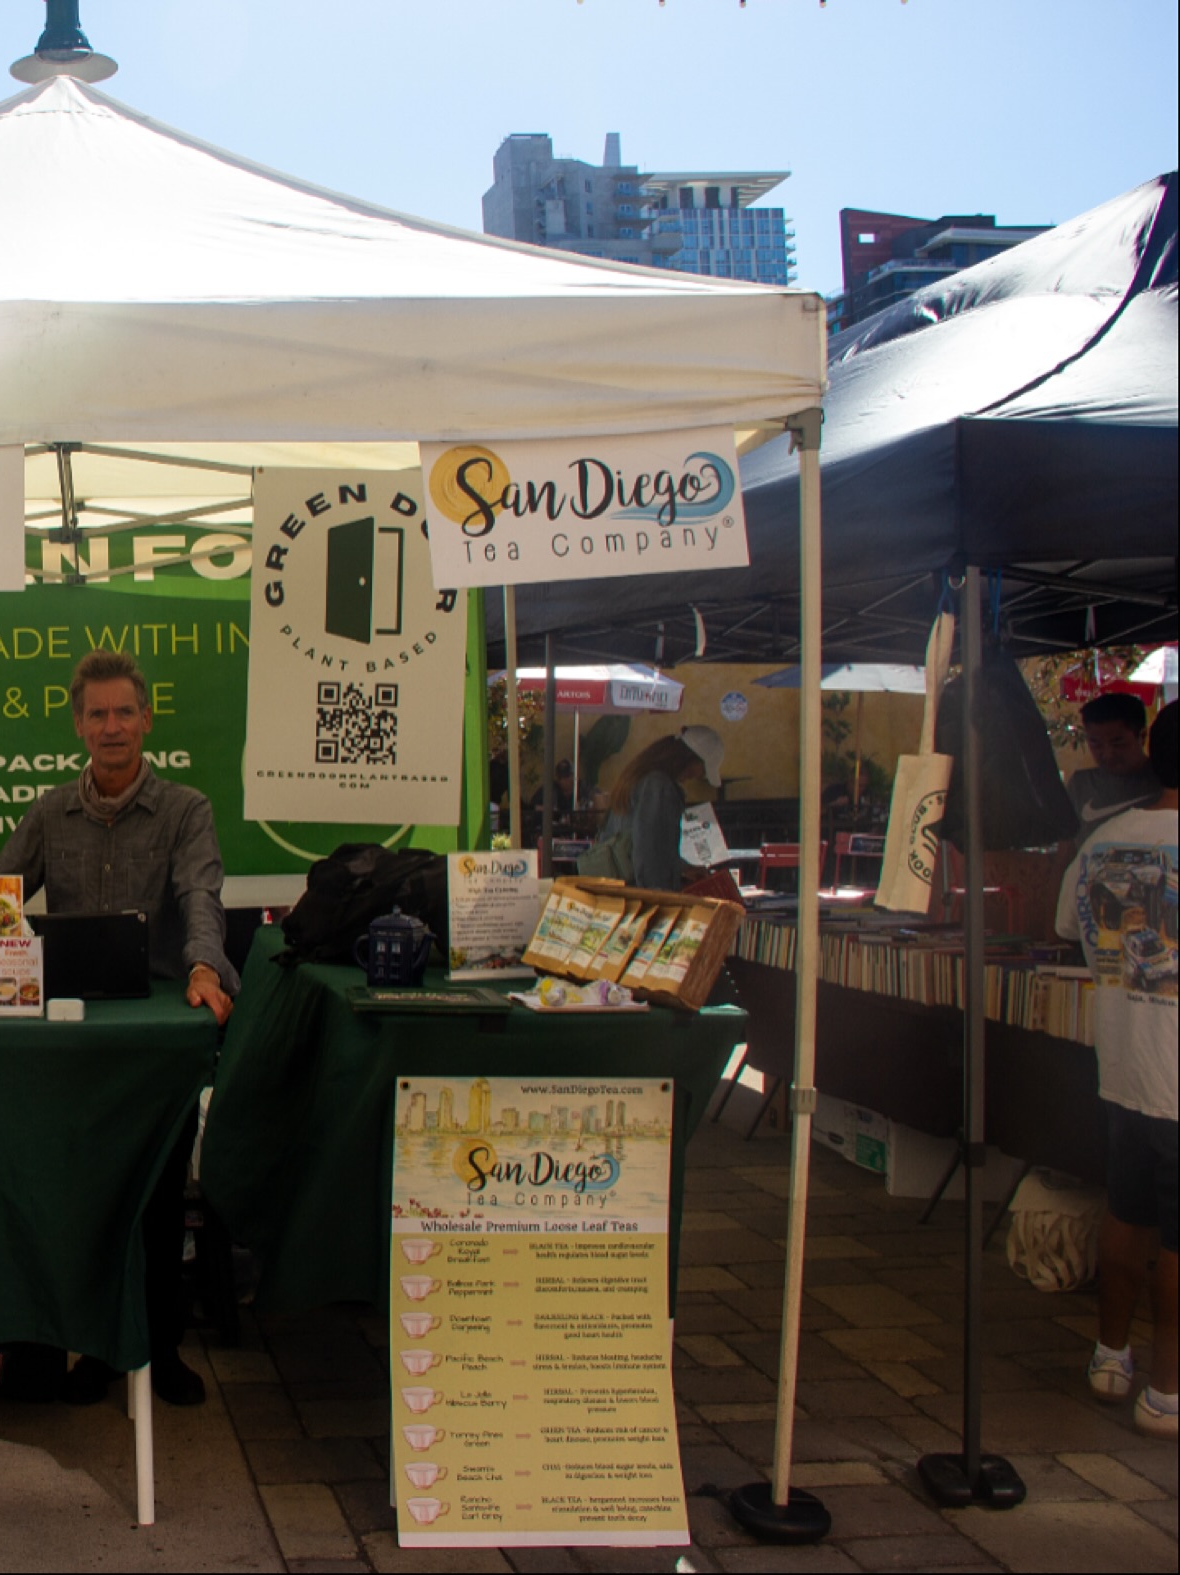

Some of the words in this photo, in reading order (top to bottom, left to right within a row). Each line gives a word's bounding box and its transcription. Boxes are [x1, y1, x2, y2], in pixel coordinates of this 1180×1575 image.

[455, 457, 568, 538] San
[568, 455, 720, 525] Diego
[264, 483, 368, 608] GREEN
[389, 491, 458, 614] DR
[463, 540, 520, 564] Tea
[85, 623, 199, 656] WITH
[279, 624, 349, 673] PLANT
[366, 630, 438, 674] BASED
[2, 686, 30, 719] &
[520, 1084, 644, 1097] www.SanDiegoTea.com
[466, 1147, 527, 1191] San
[528, 1151, 609, 1193] Diego
[467, 1192, 498, 1206] Tea
[420, 1220, 483, 1233] Wholesale
[486, 1220, 540, 1233] Premium
[544, 1220, 578, 1233] Loose
[581, 1220, 607, 1233] Leaf
[610, 1220, 639, 1233] Teas
